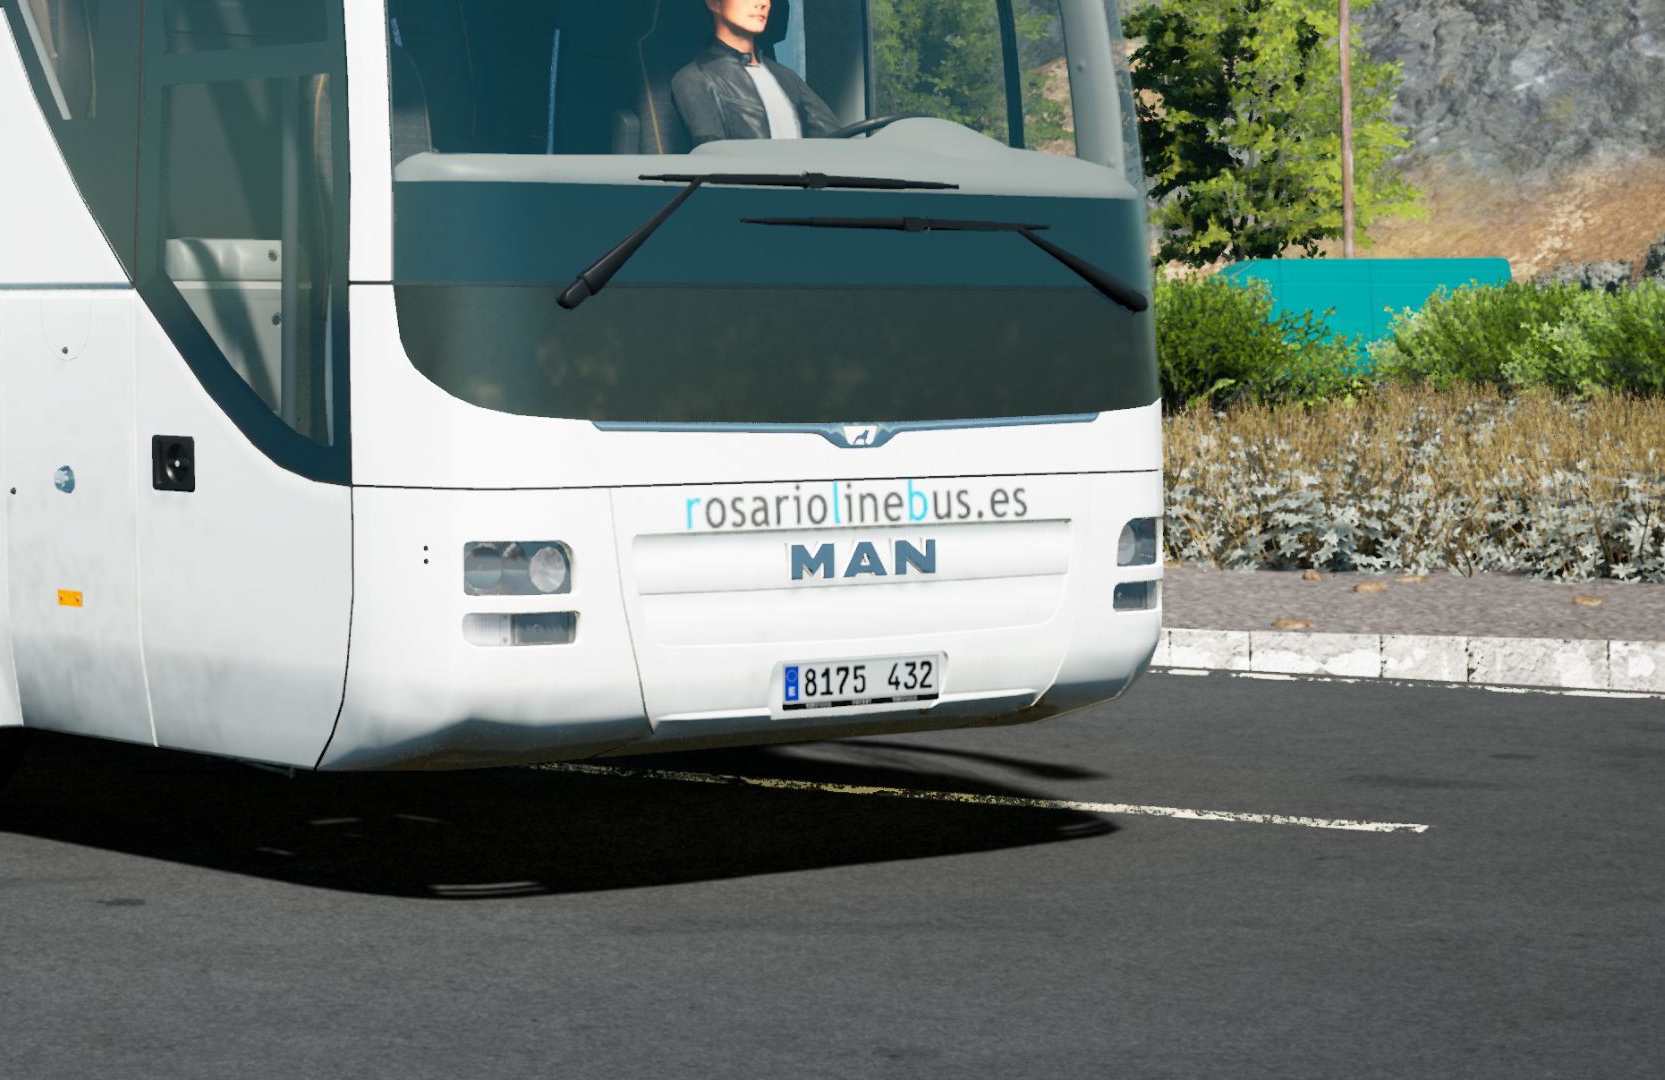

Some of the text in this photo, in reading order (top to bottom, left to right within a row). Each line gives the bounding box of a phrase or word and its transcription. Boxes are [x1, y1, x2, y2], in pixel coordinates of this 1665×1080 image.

[686, 478, 1028, 530] rosariolinebus.es
[790, 538, 936, 580] MAN
[804, 665, 866, 697] 8175
[888, 661, 933, 691] 432
